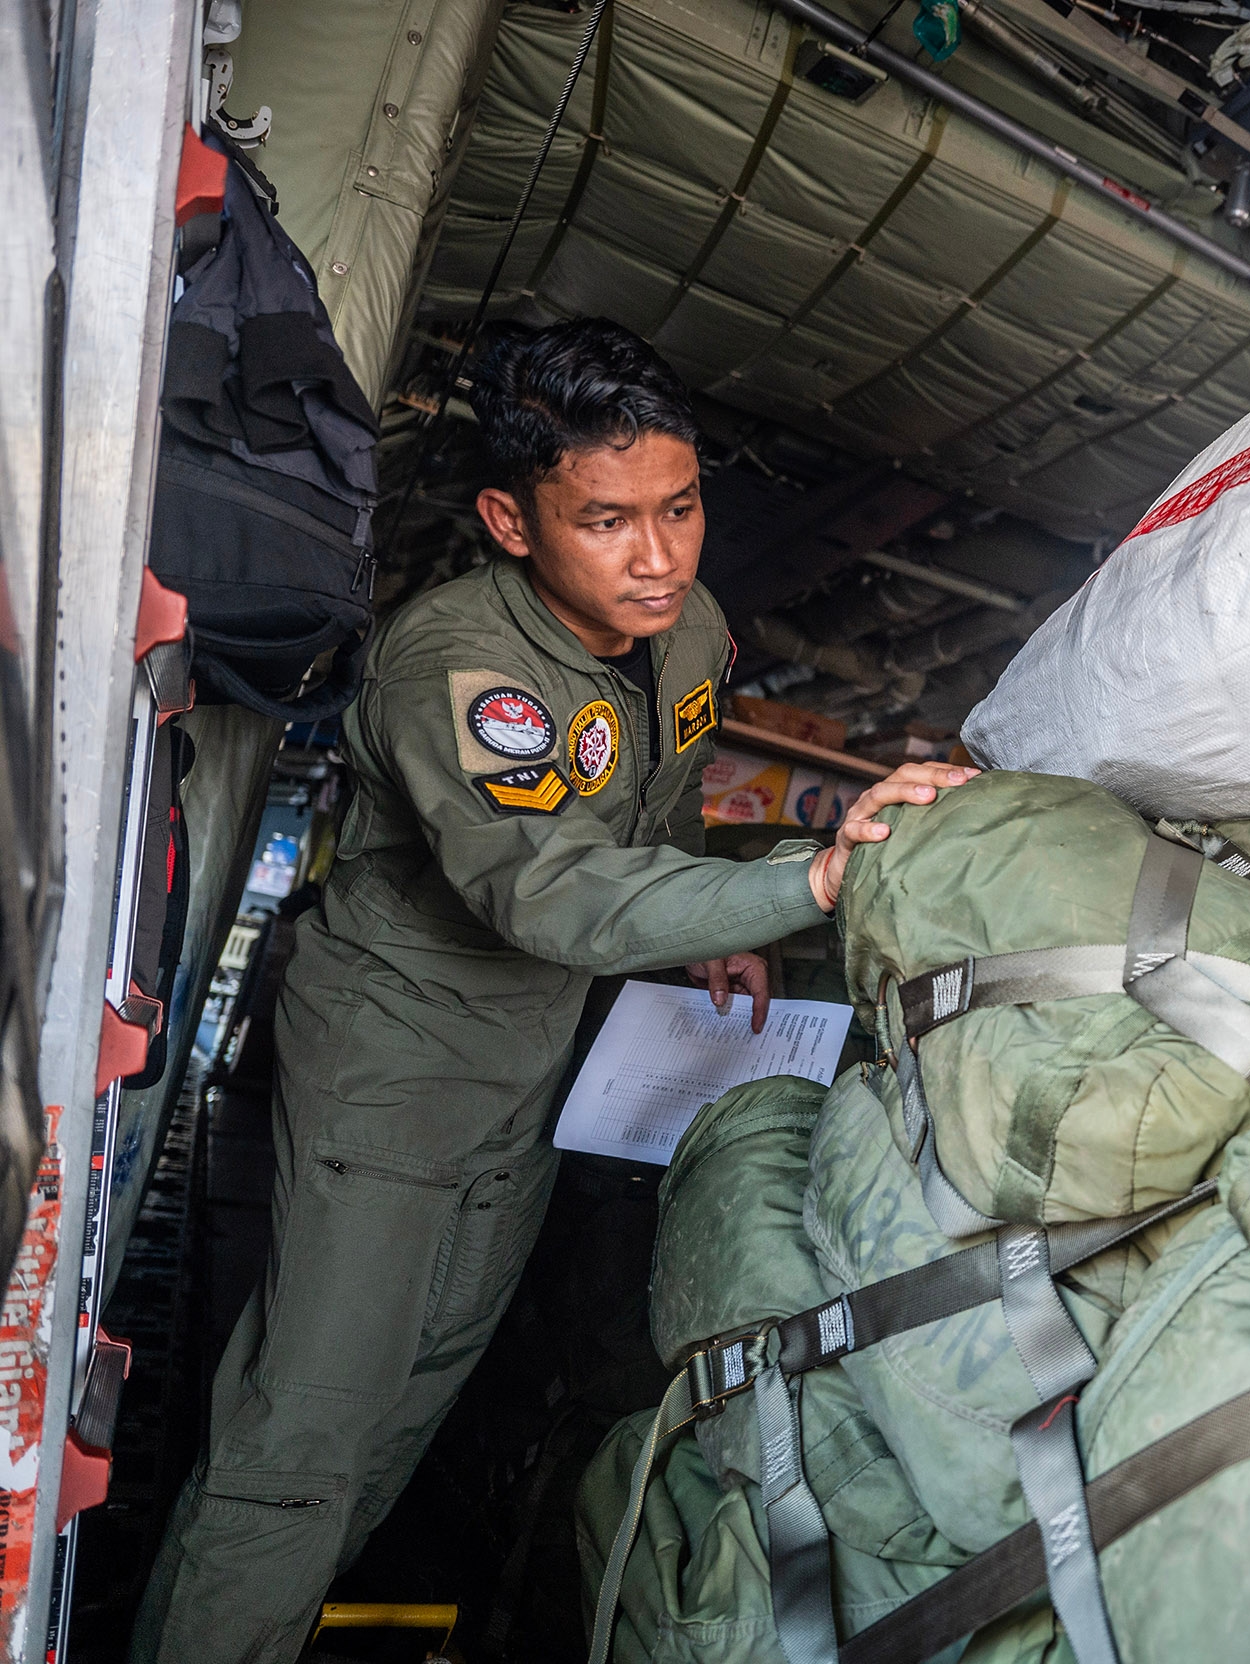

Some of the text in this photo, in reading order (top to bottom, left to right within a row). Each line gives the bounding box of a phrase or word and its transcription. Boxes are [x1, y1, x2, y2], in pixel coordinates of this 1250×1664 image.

[479, 693, 544, 715] SATUAN TUGAS
[478, 728, 504, 751] GARUDA
[503, 746, 532, 756] MERAH
[501, 770, 539, 786] TNI
